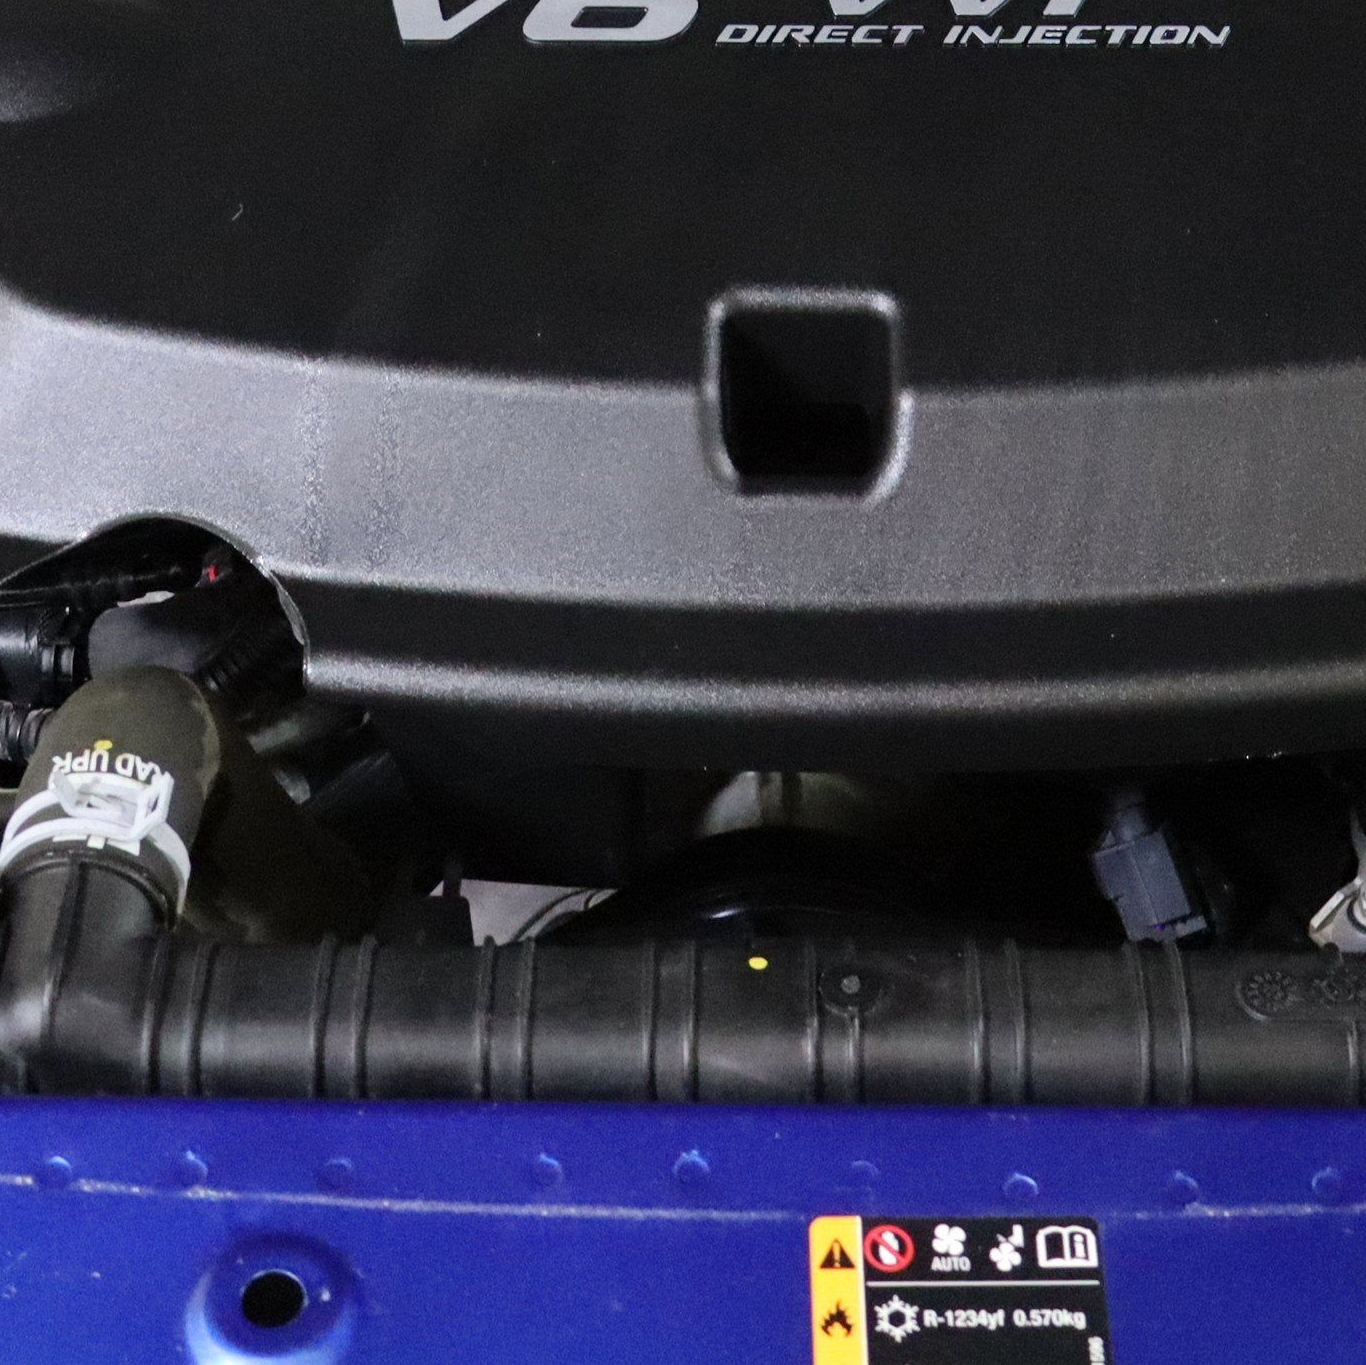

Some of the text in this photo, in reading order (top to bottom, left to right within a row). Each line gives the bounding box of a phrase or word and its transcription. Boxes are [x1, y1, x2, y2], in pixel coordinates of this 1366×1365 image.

[715, 24, 1231, 49] DIRECT INJECTION
[931, 1256, 971, 1272] AUTO
[922, 1308, 1087, 1331] R-1234yf 0.570kg
